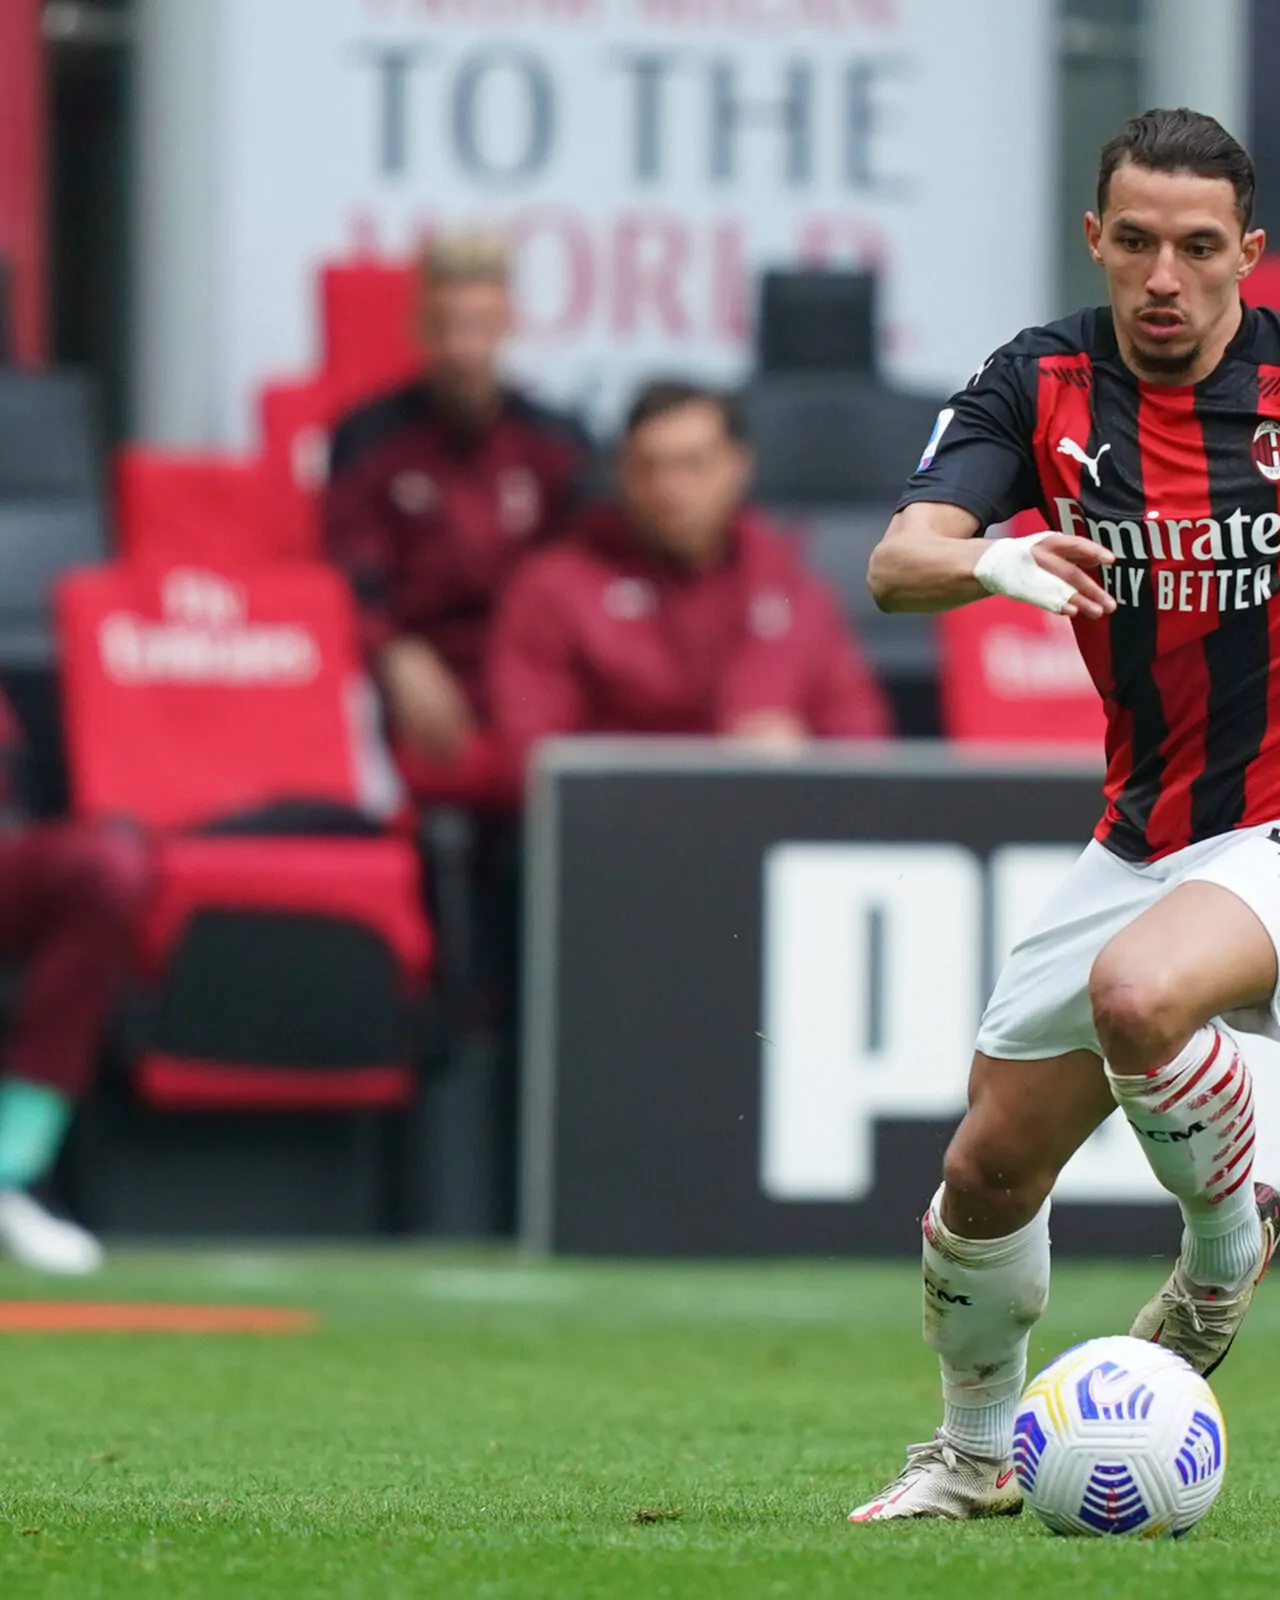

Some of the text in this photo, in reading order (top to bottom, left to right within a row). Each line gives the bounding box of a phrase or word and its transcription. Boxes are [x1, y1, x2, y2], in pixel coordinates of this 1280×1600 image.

[348, 38, 924, 204] TO THE
[1102, 564, 1272, 613] FLY BETTER
